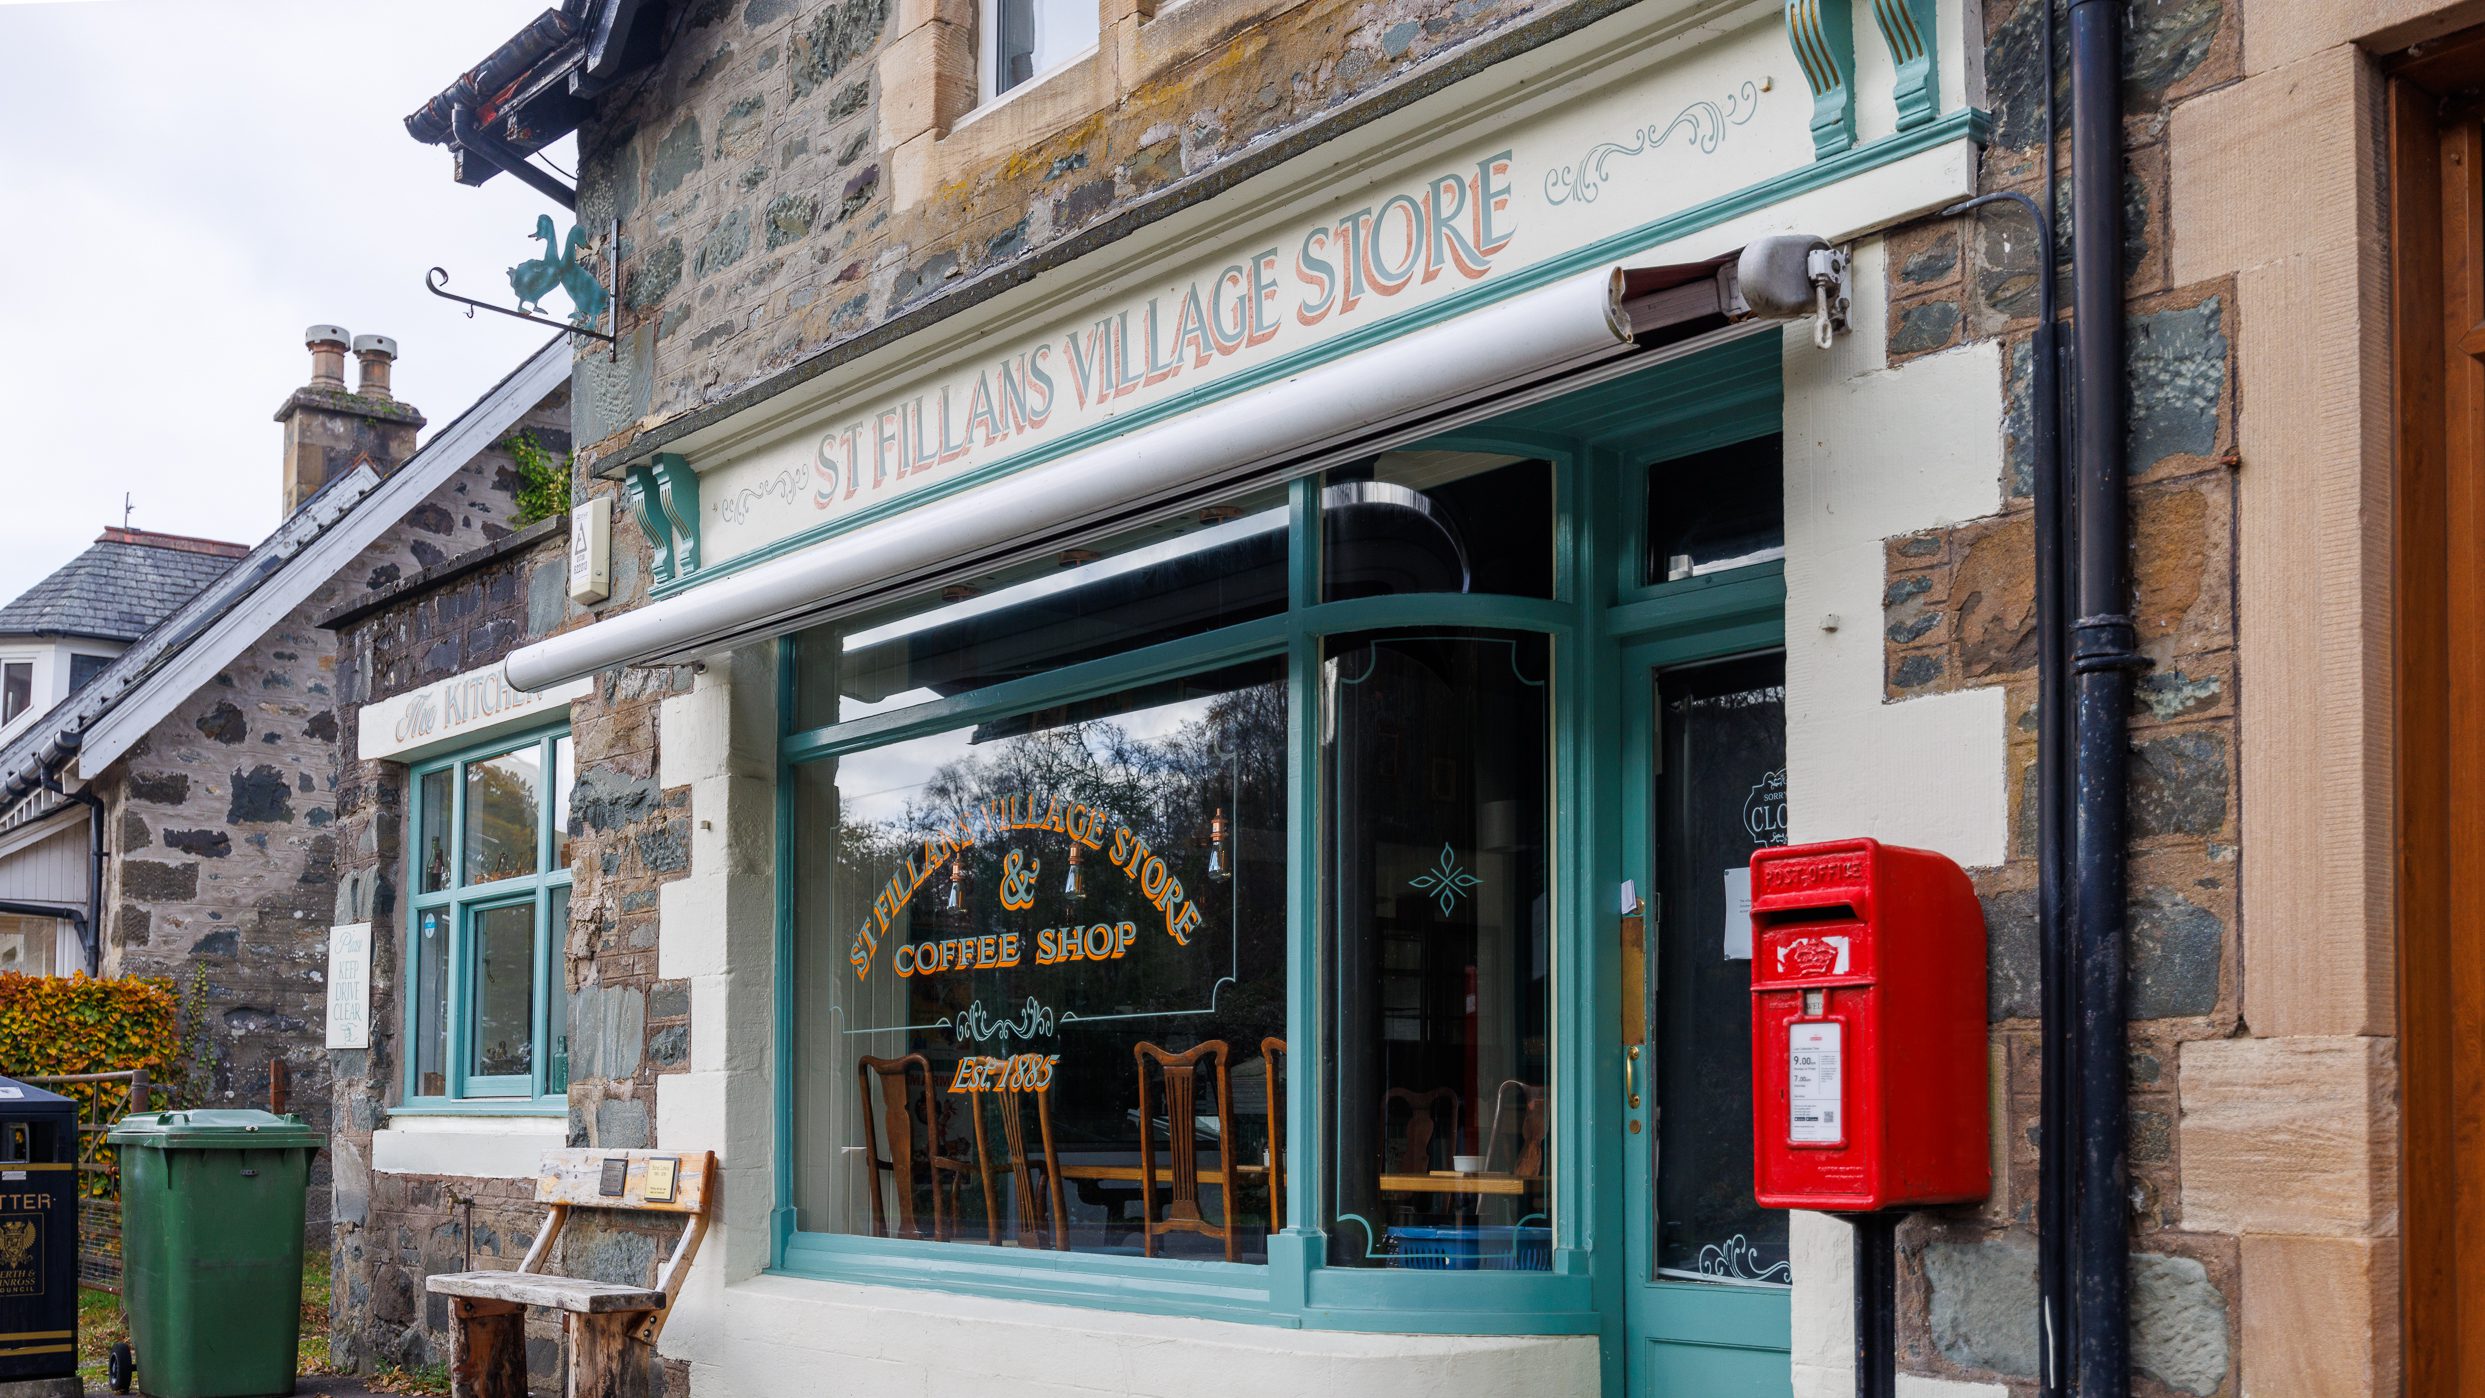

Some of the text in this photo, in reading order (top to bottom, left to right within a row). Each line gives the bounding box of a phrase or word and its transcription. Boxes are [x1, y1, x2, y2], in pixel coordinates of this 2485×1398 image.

[814, 149, 1518, 511] ST FILLANS VILLAGE STORE
[395, 692, 438, 744] The
[1764, 791, 1787, 801] SORR
[849, 790, 1203, 982] ST FILLANS VILLAGE STORE
[1000, 848, 1040, 912] &
[1765, 862, 1862, 884] POST OFFICE
[338, 960, 359, 979] KEEP
[893, 920, 1137, 978] COFFEE SHOP
[333, 1002, 362, 1021] CLEAR
[335, 982, 360, 1001] DRIVE
[992, 1053, 1060, 1094] 1885
